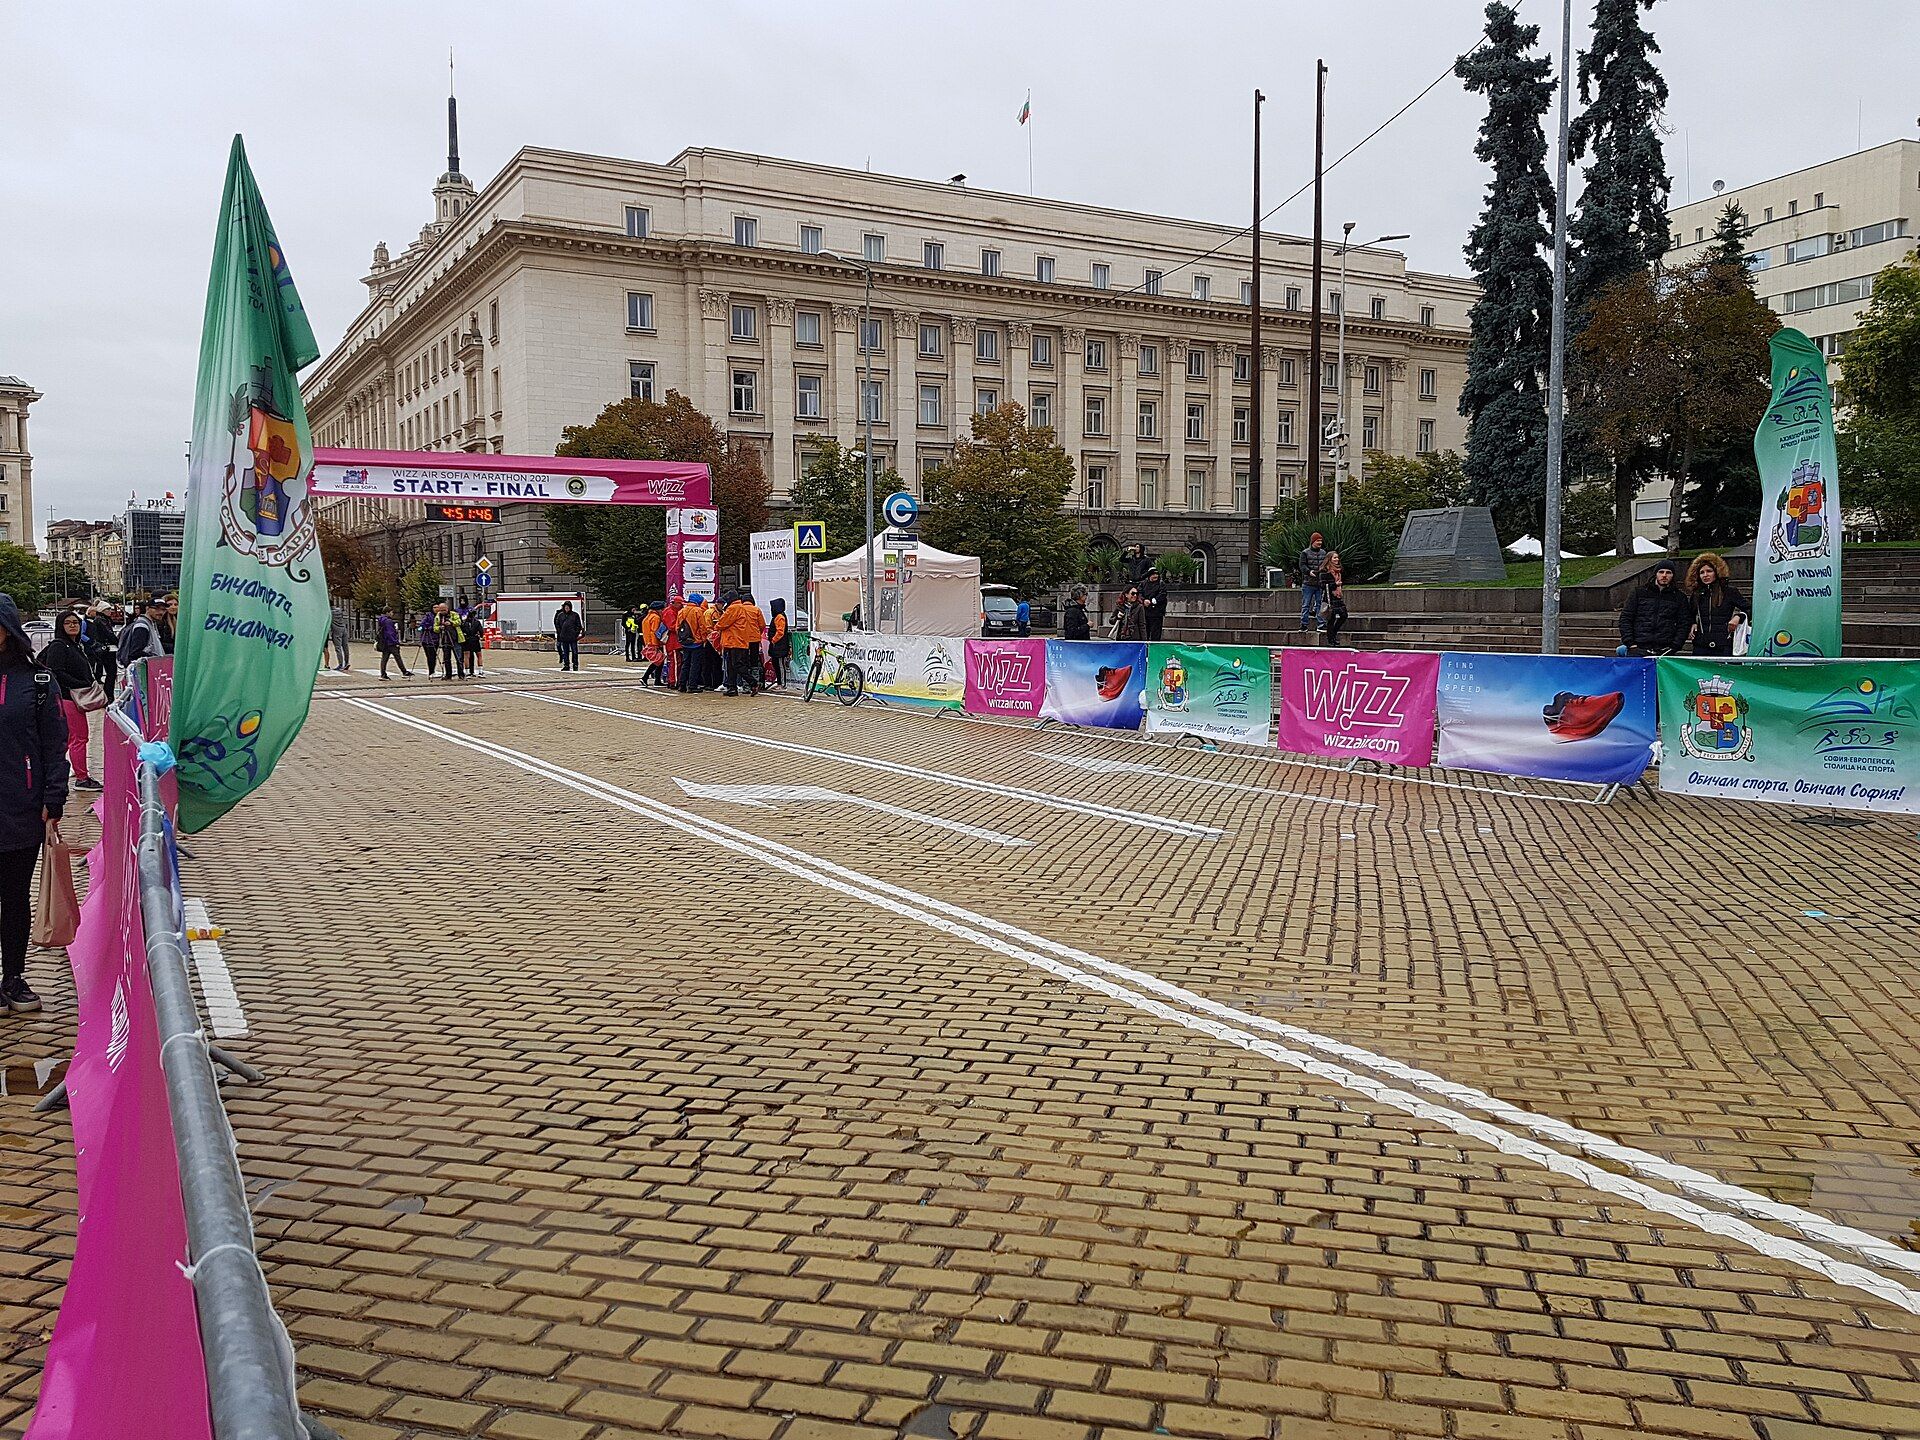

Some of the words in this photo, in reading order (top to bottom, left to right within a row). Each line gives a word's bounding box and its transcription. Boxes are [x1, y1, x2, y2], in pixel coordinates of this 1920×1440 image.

[392, 469, 418, 478] WIZZ
[421, 471, 438, 479] AIR
[440, 471, 470, 480] SOFIA
[473, 473, 527, 482] MARATHON
[530, 475, 550, 483] 2021
[393, 478, 463, 494] START
[486, 482, 550, 497] FINAL
[752, 541, 766, 551] WIZZ
[767, 540, 776, 550] AIR
[776, 538, 792, 549] SOFIA
[758, 551, 787, 561] MARATHON
[1447, 661, 1474, 669] FIND
[1446, 673, 1474, 681] YOUR
[1444, 683, 1481, 693] SPEED
[988, 698, 1033, 711] wizzair.com
[1323, 731, 1400, 754] wizzair.com
[1823, 762, 1856, 771] СТОЛИЦА
[1867, 765, 1896, 773] СПОРТА
[1688, 770, 1740, 788] Обичам
[1793, 778, 1846, 797] Обичам
[1849, 782, 1906, 803] София!
